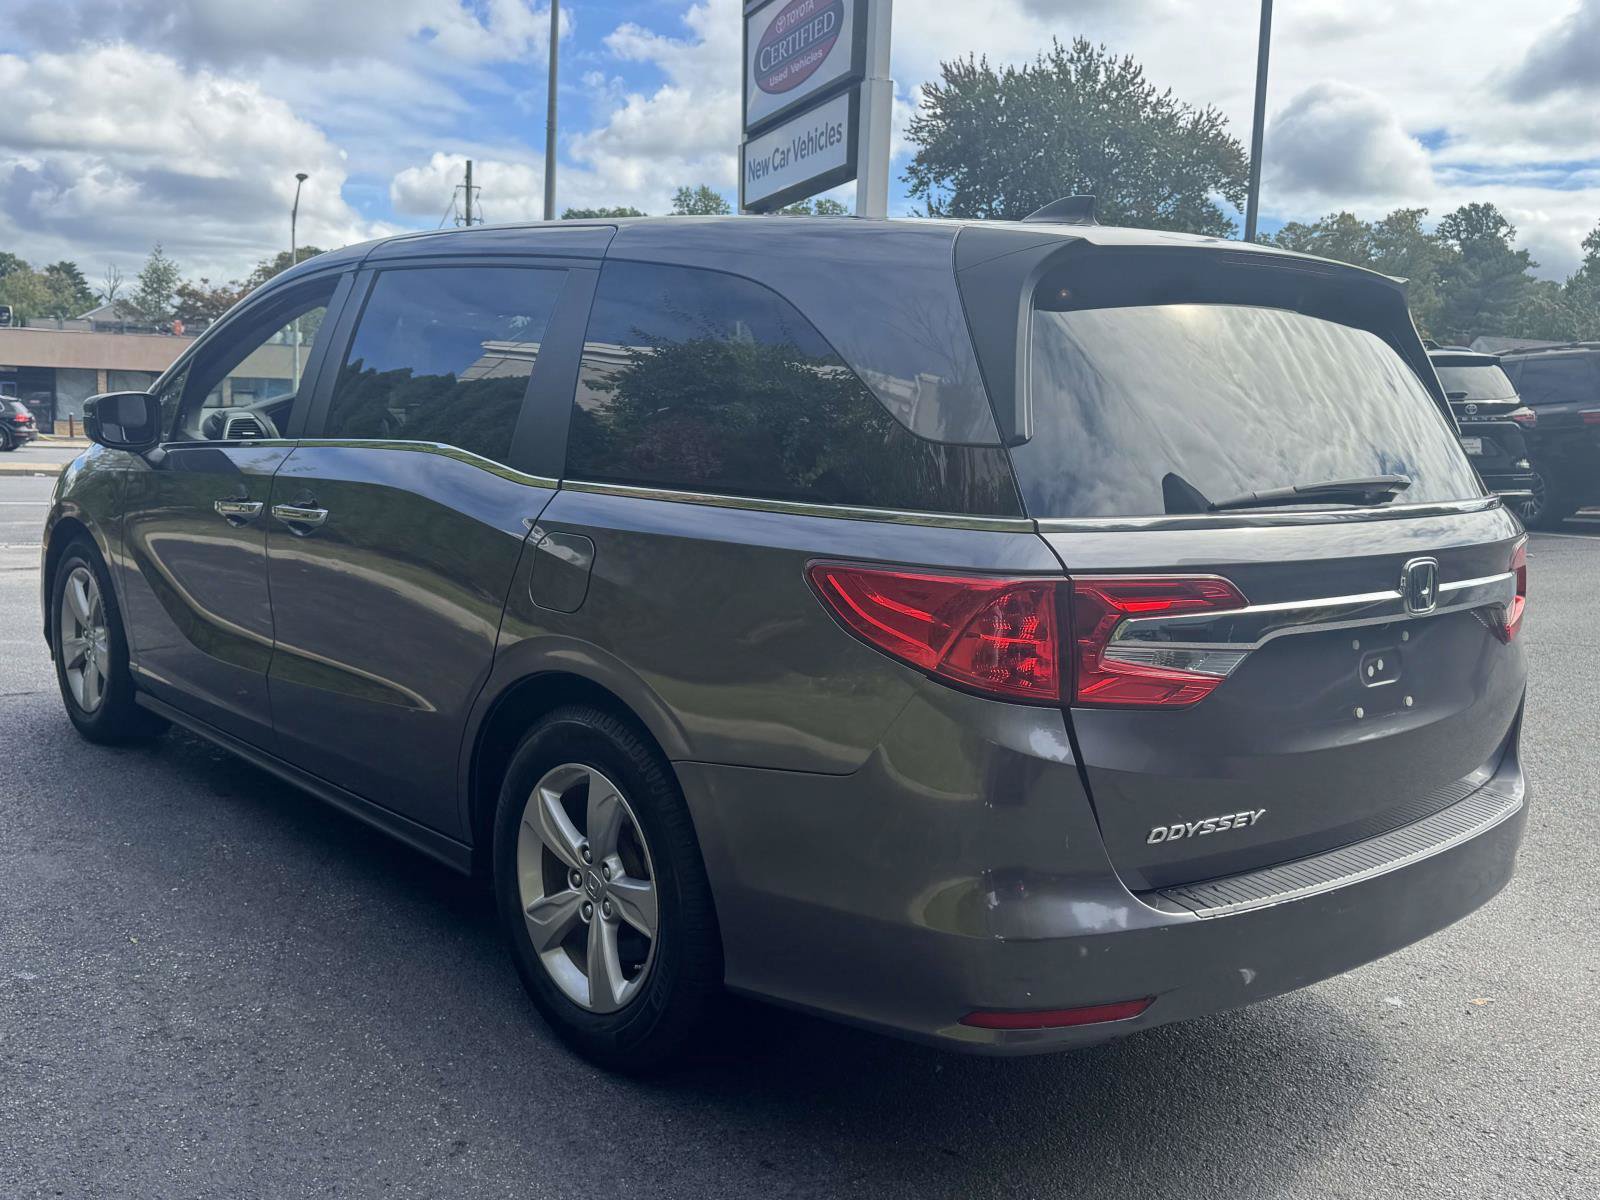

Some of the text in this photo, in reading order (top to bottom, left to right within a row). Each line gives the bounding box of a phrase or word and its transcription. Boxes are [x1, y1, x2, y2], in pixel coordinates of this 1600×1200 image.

[786, 0, 815, 25] TOYOTA
[760, 11, 835, 72] CERTIFIED
[769, 49, 823, 86] Used Vehicles
[748, 121, 842, 183] New Car Vehicles
[1147, 808, 1266, 844] ODYSSEY
